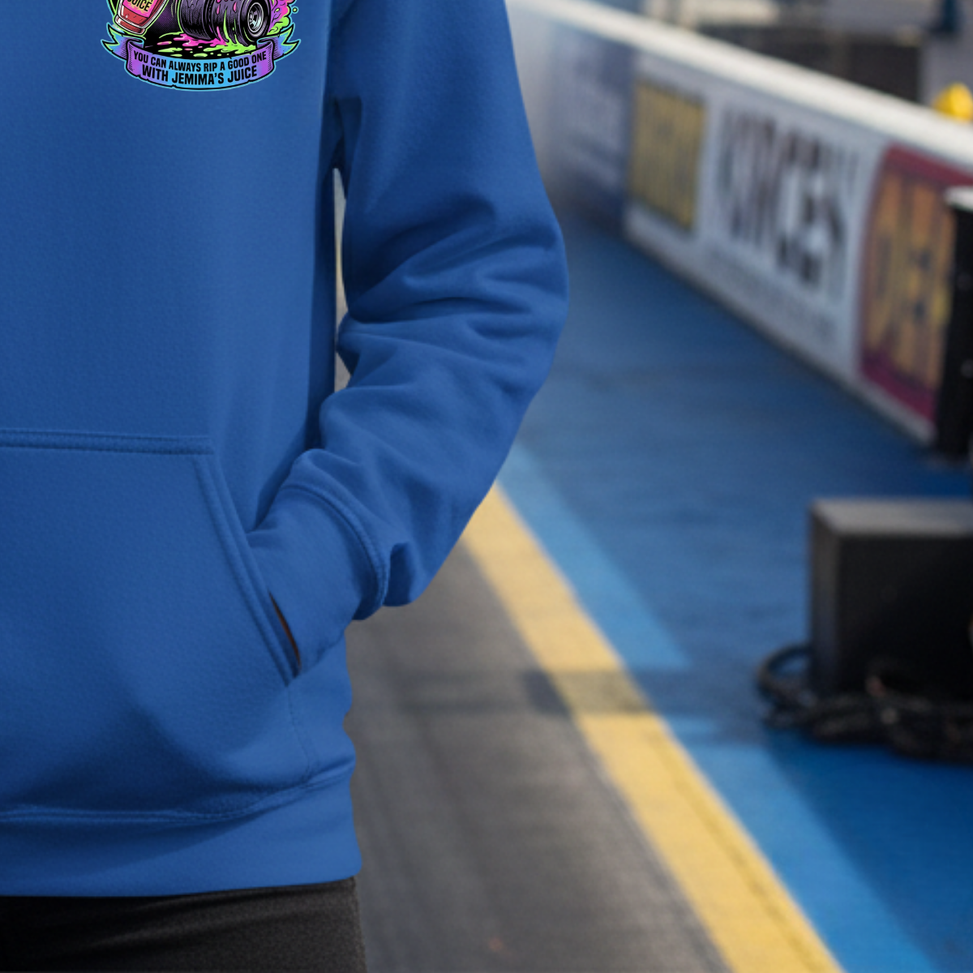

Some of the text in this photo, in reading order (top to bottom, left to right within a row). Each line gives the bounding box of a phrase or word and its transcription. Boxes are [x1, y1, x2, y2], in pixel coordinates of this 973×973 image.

[133, 50, 267, 72] YOU CAN ALWAYS RIP A GOOD ONE
[142, 64, 258, 85] WITH JEMIMA'S JUICE
